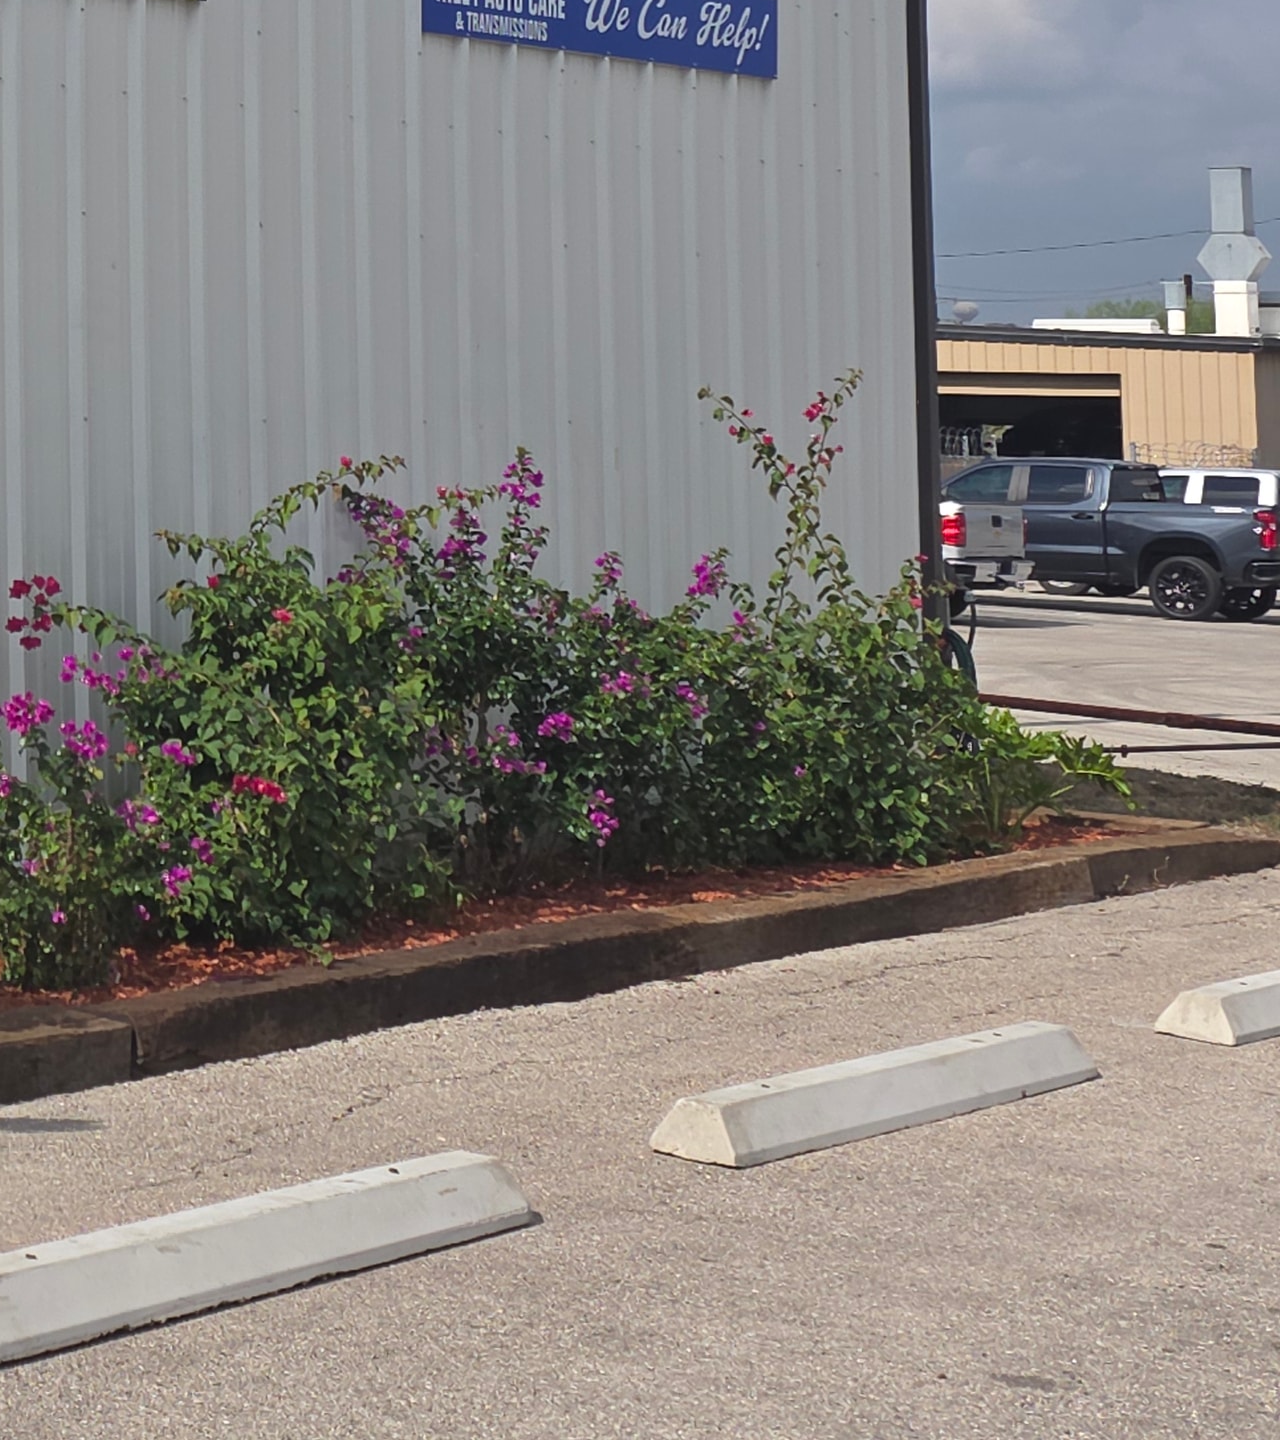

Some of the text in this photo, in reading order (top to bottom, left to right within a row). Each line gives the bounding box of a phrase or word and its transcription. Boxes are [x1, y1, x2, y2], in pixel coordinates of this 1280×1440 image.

[455, 11, 549, 43] & TRANSMISSIONS
[696, 0, 770, 66] Help!
